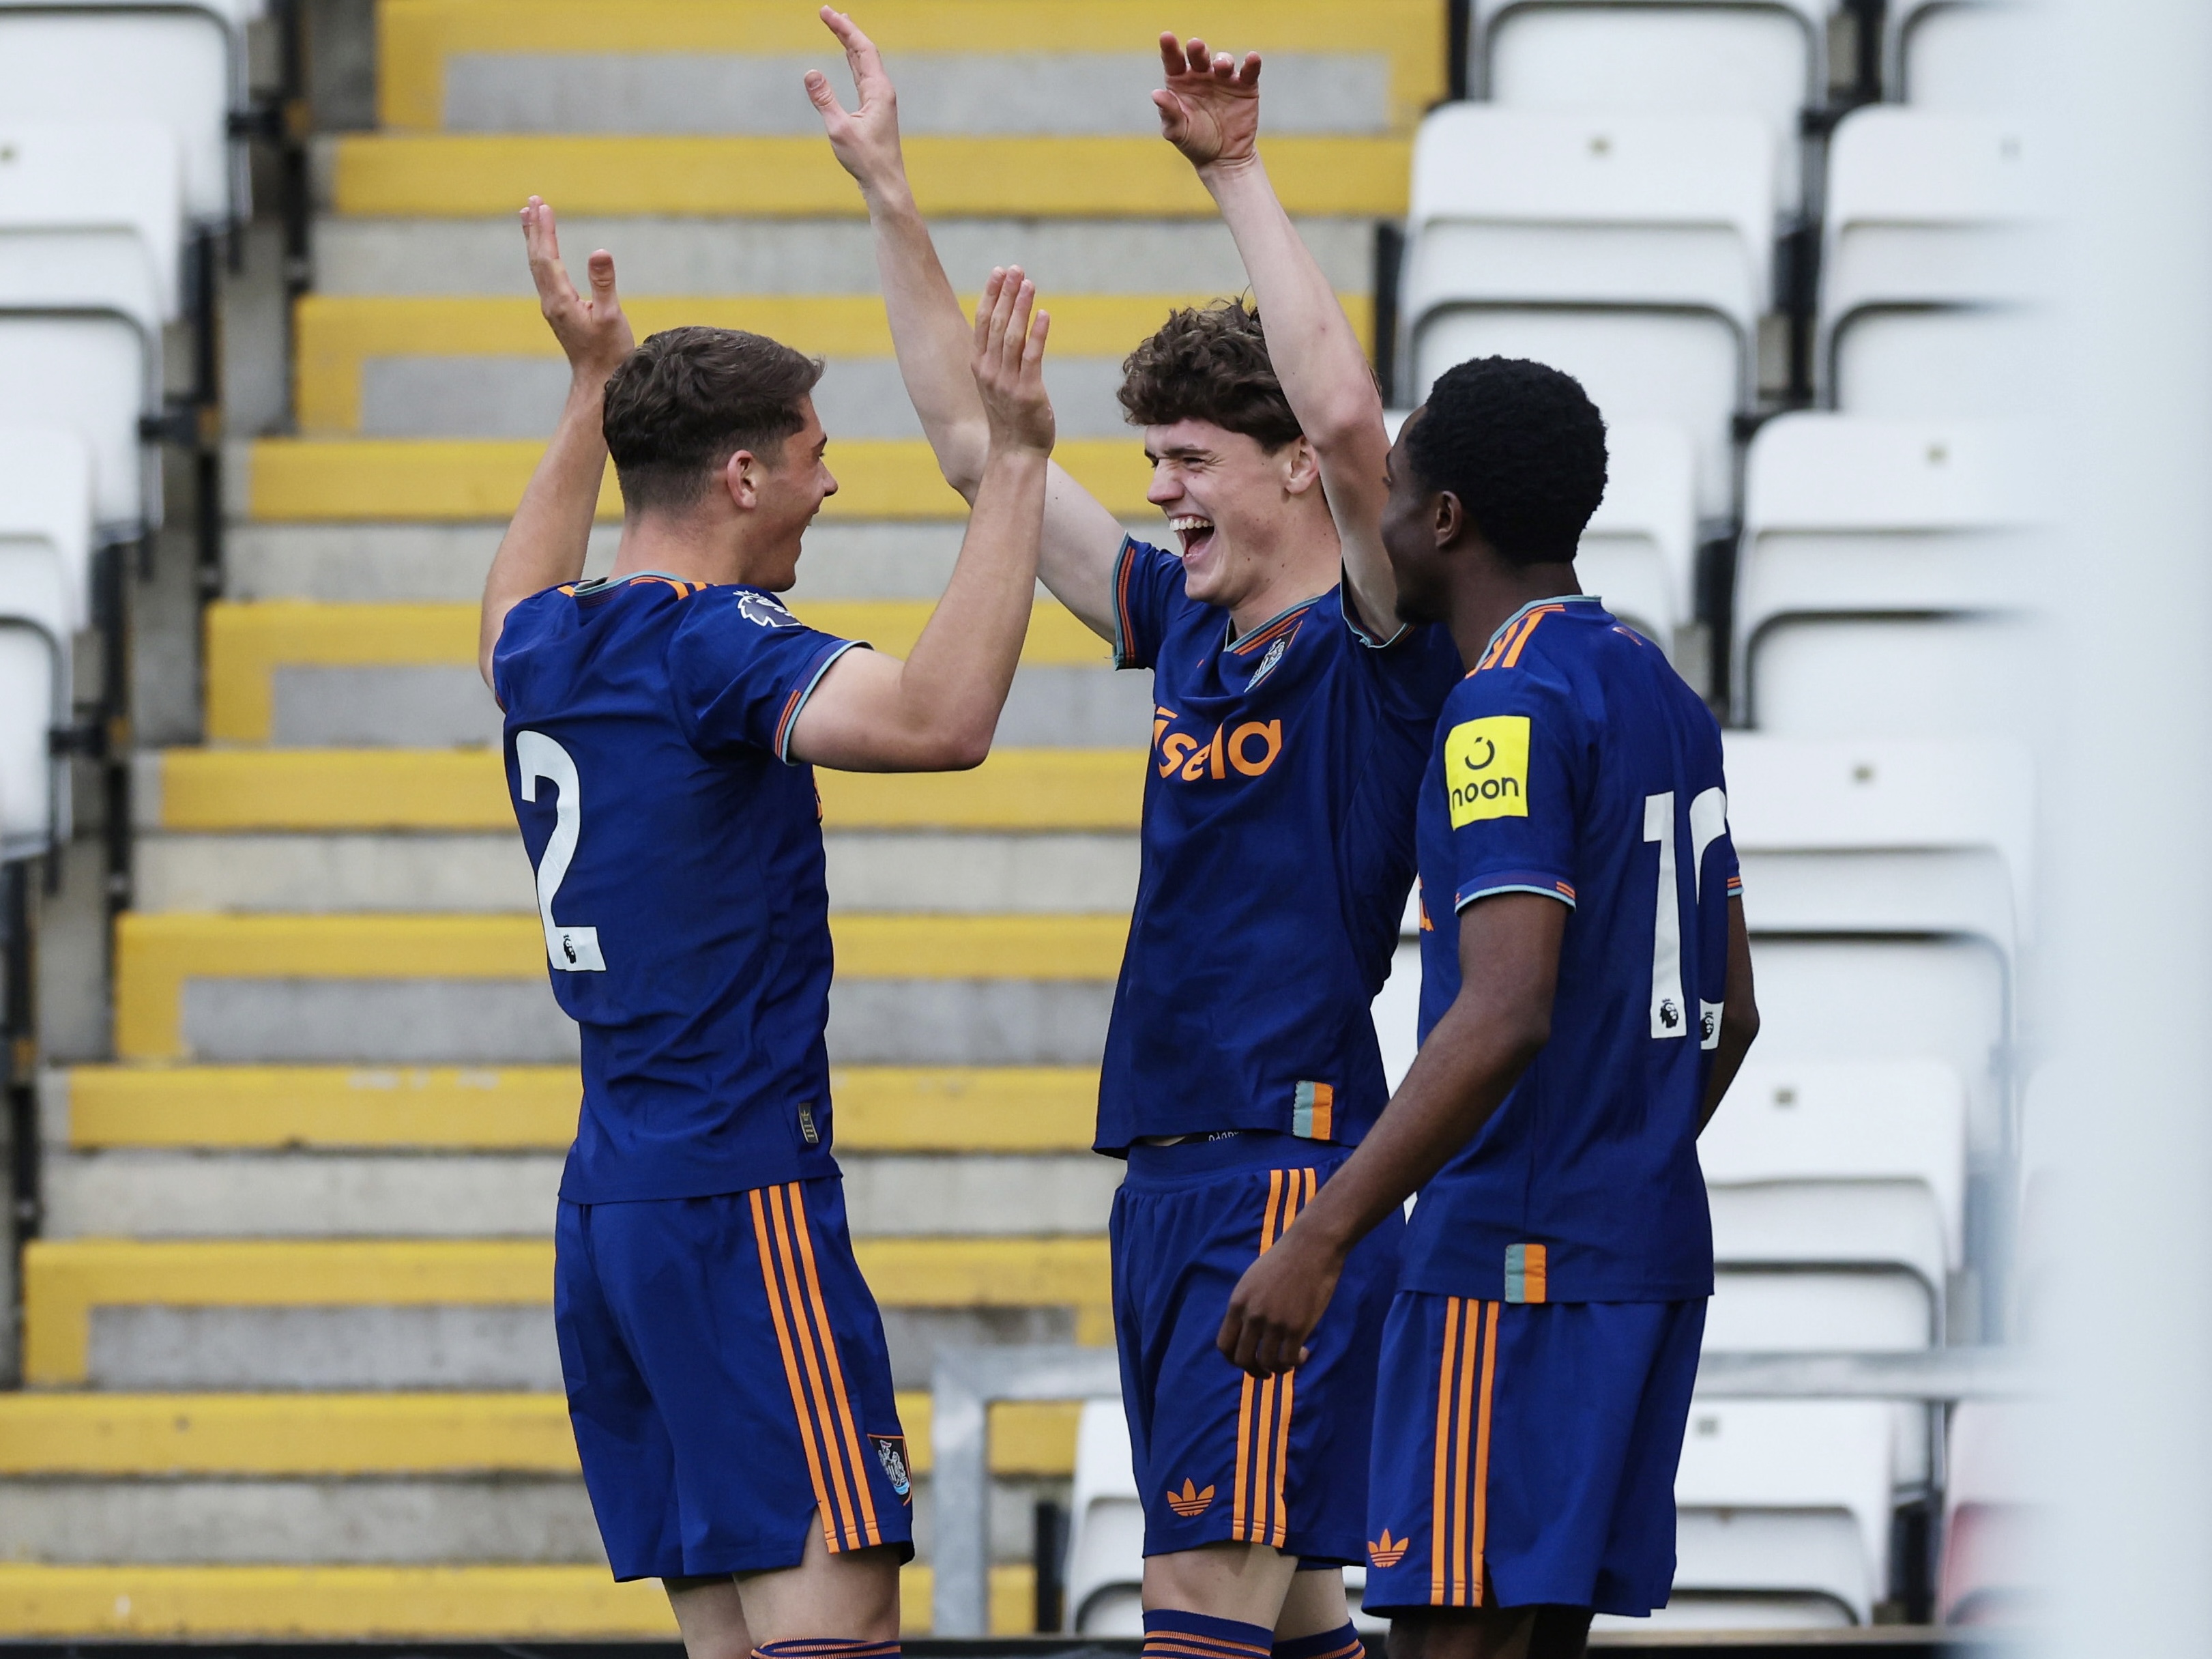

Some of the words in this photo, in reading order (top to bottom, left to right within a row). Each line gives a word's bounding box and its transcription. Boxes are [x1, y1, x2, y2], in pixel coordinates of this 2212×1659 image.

[1159, 719, 1282, 781] sela
[1452, 777, 1519, 811] noon
[516, 730, 607, 972] 2
